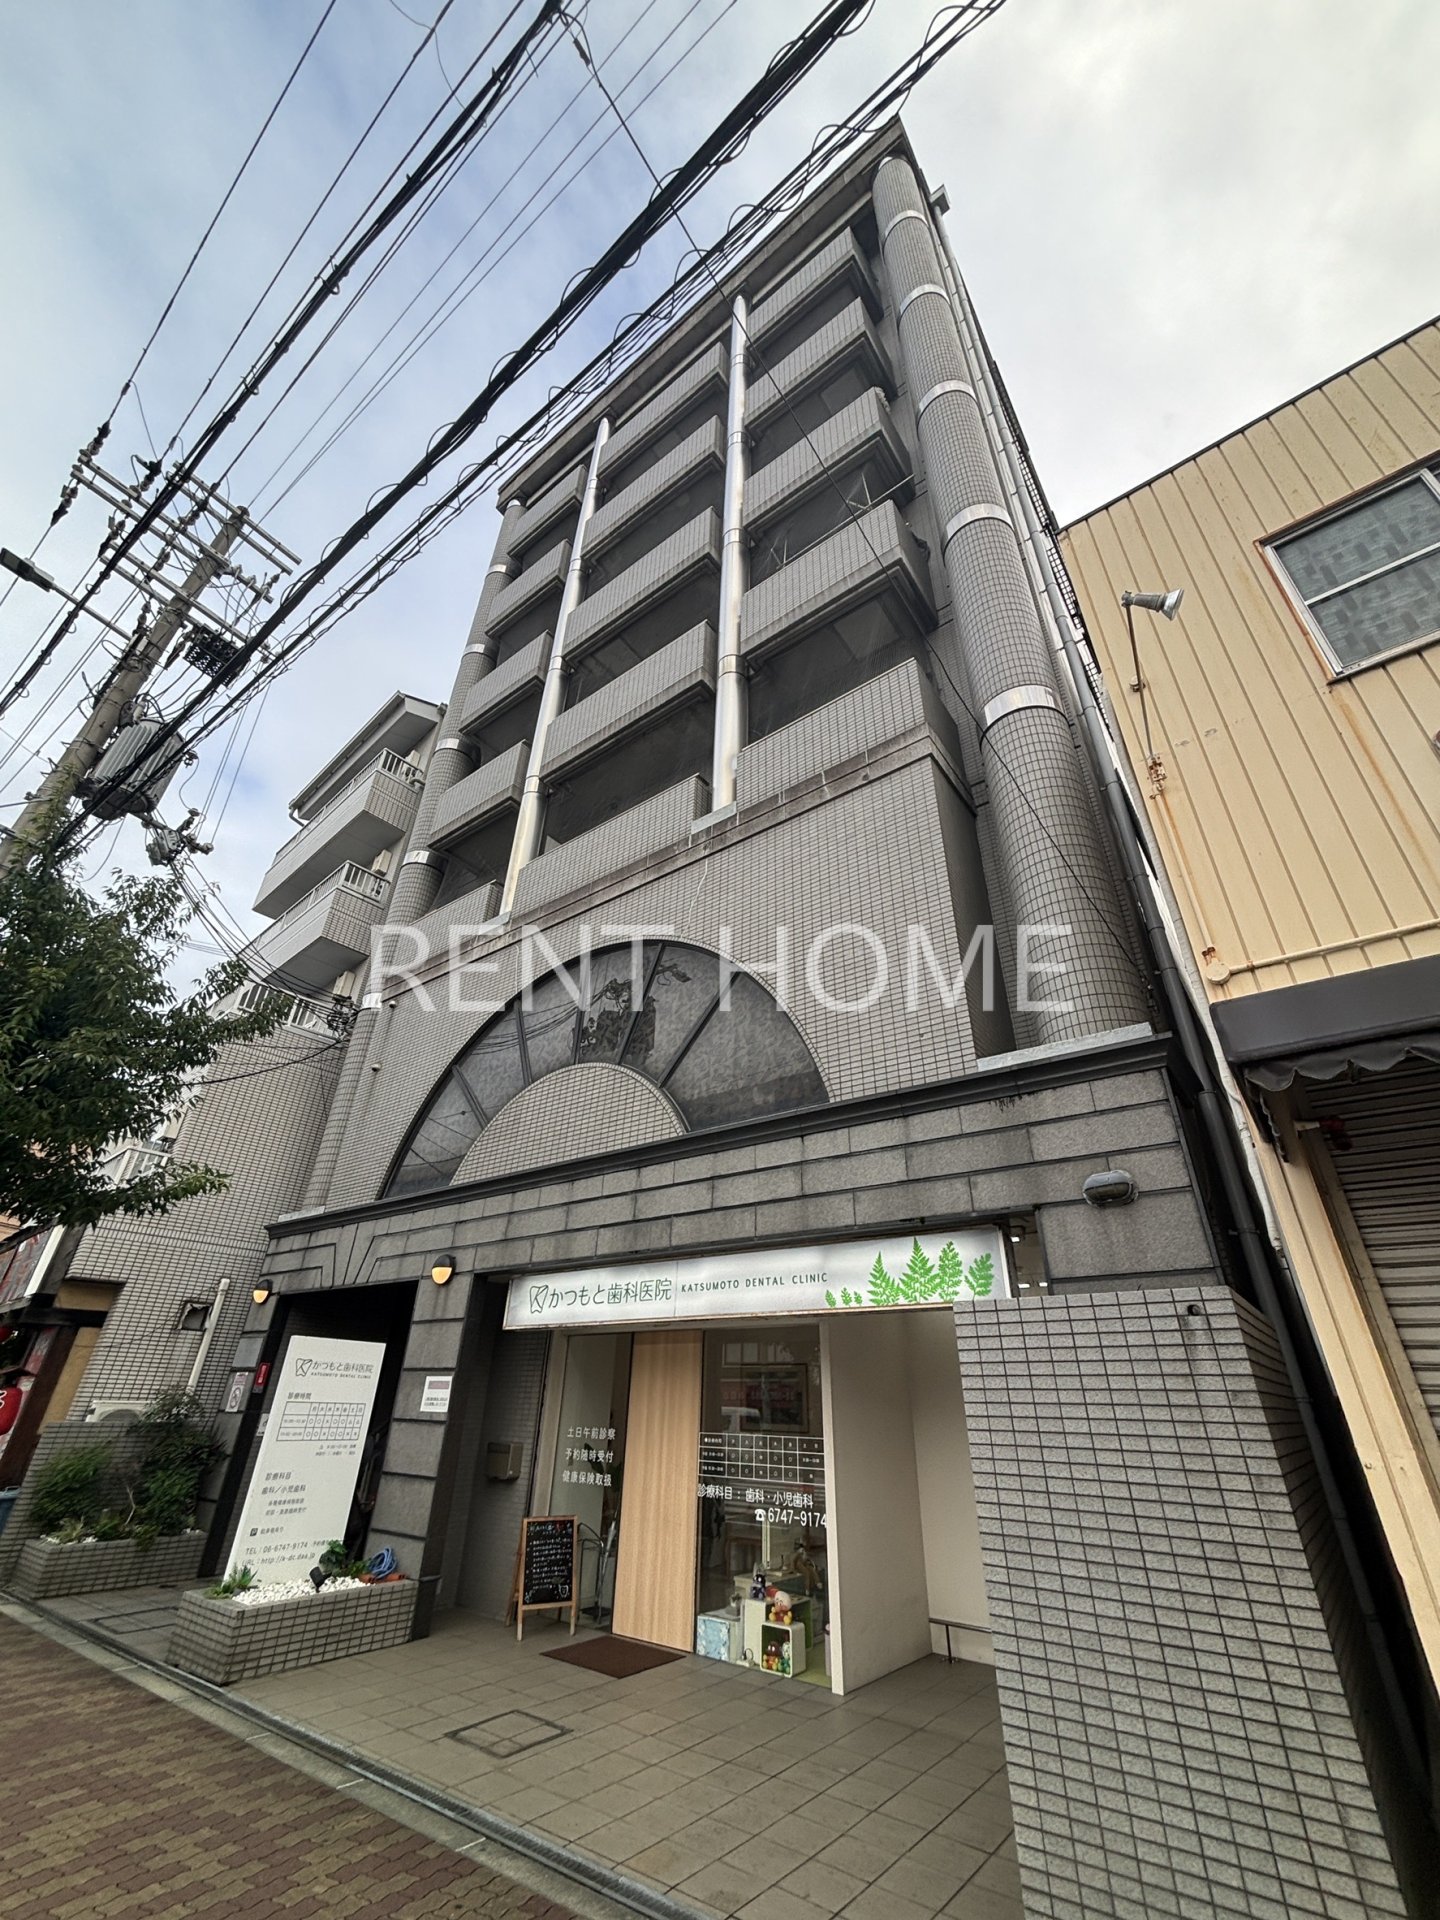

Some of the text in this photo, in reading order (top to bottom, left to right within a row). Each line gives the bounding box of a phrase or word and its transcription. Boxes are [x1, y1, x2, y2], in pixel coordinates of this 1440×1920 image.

[681, 1272, 828, 1292] KATSUMOTO DENTAL CLINIC
[548, 1277, 672, 1308] かつもと歯科医院
[312, 1360, 374, 1374] かつもと歯科医院
[567, 1426, 616, 1440] 土日午前診察
[565, 1447, 614, 1463] 予約随時受付
[562, 1470, 612, 1487] 健康保険取扱
[767, 1507, 827, 1528] 6747-9174
